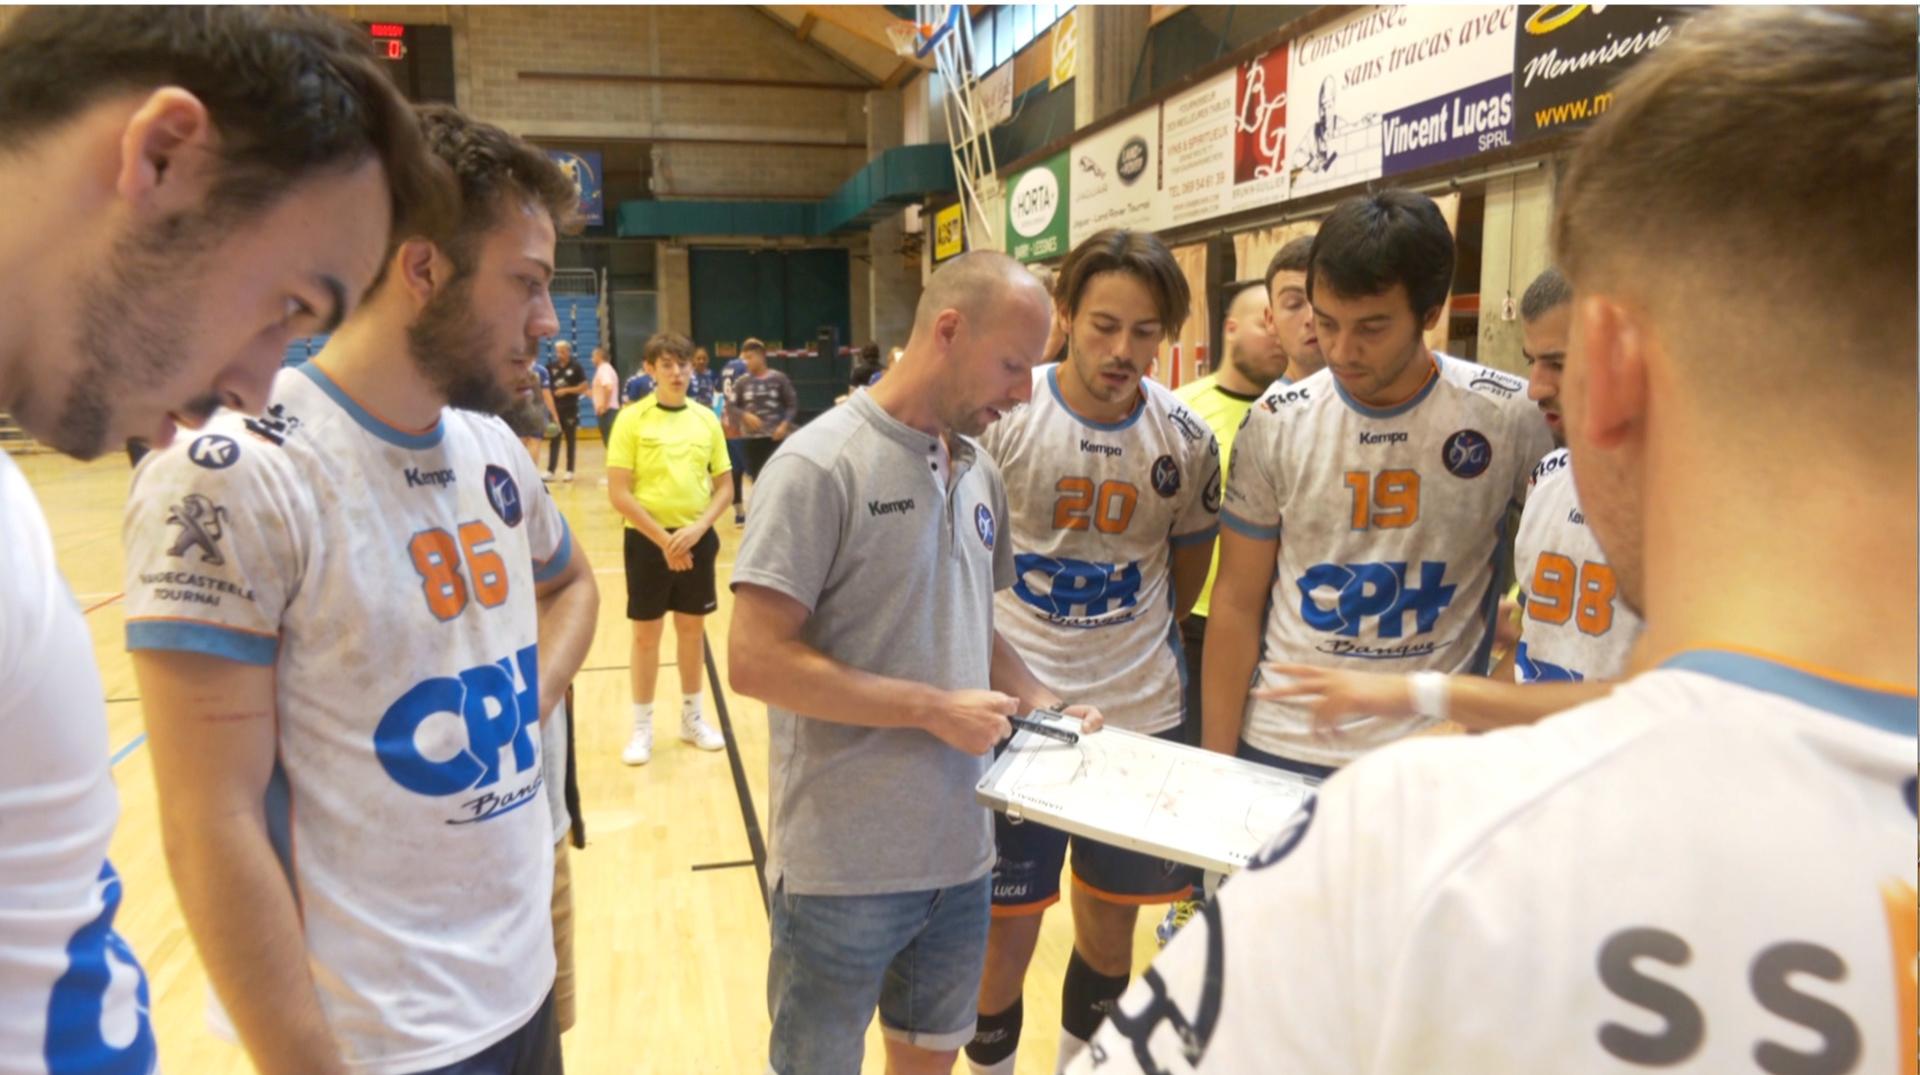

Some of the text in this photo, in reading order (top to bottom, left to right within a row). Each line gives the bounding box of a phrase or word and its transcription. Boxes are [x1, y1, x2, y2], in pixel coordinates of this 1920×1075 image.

[1342, 55, 1384, 89] sans
[1388, 28, 1453, 73] tracas
[1458, 5, 1514, 46] avec
[1523, 16, 1672, 88] Menuiserie
[1383, 92, 1512, 157] Vincent Lucas
[1478, 129, 1511, 152] SPRL
[1016, 185, 1050, 217] HORTA
[1079, 439, 1122, 457] Kempa
[1359, 429, 1408, 446] Kempa
[868, 497, 916, 517] Kempa
[1052, 475, 1138, 535] 20
[1343, 469, 1421, 532] 19
[154, 588, 221, 607] TOURNAI
[408, 520, 510, 623] 86
[1011, 553, 1142, 617] CPH
[1296, 561, 1457, 638] CPH
[1526, 550, 1617, 637] 98
[1316, 638, 1453, 660] Banque
[373, 643, 541, 797] CPH
[993, 884, 1027, 897] LUCAS
